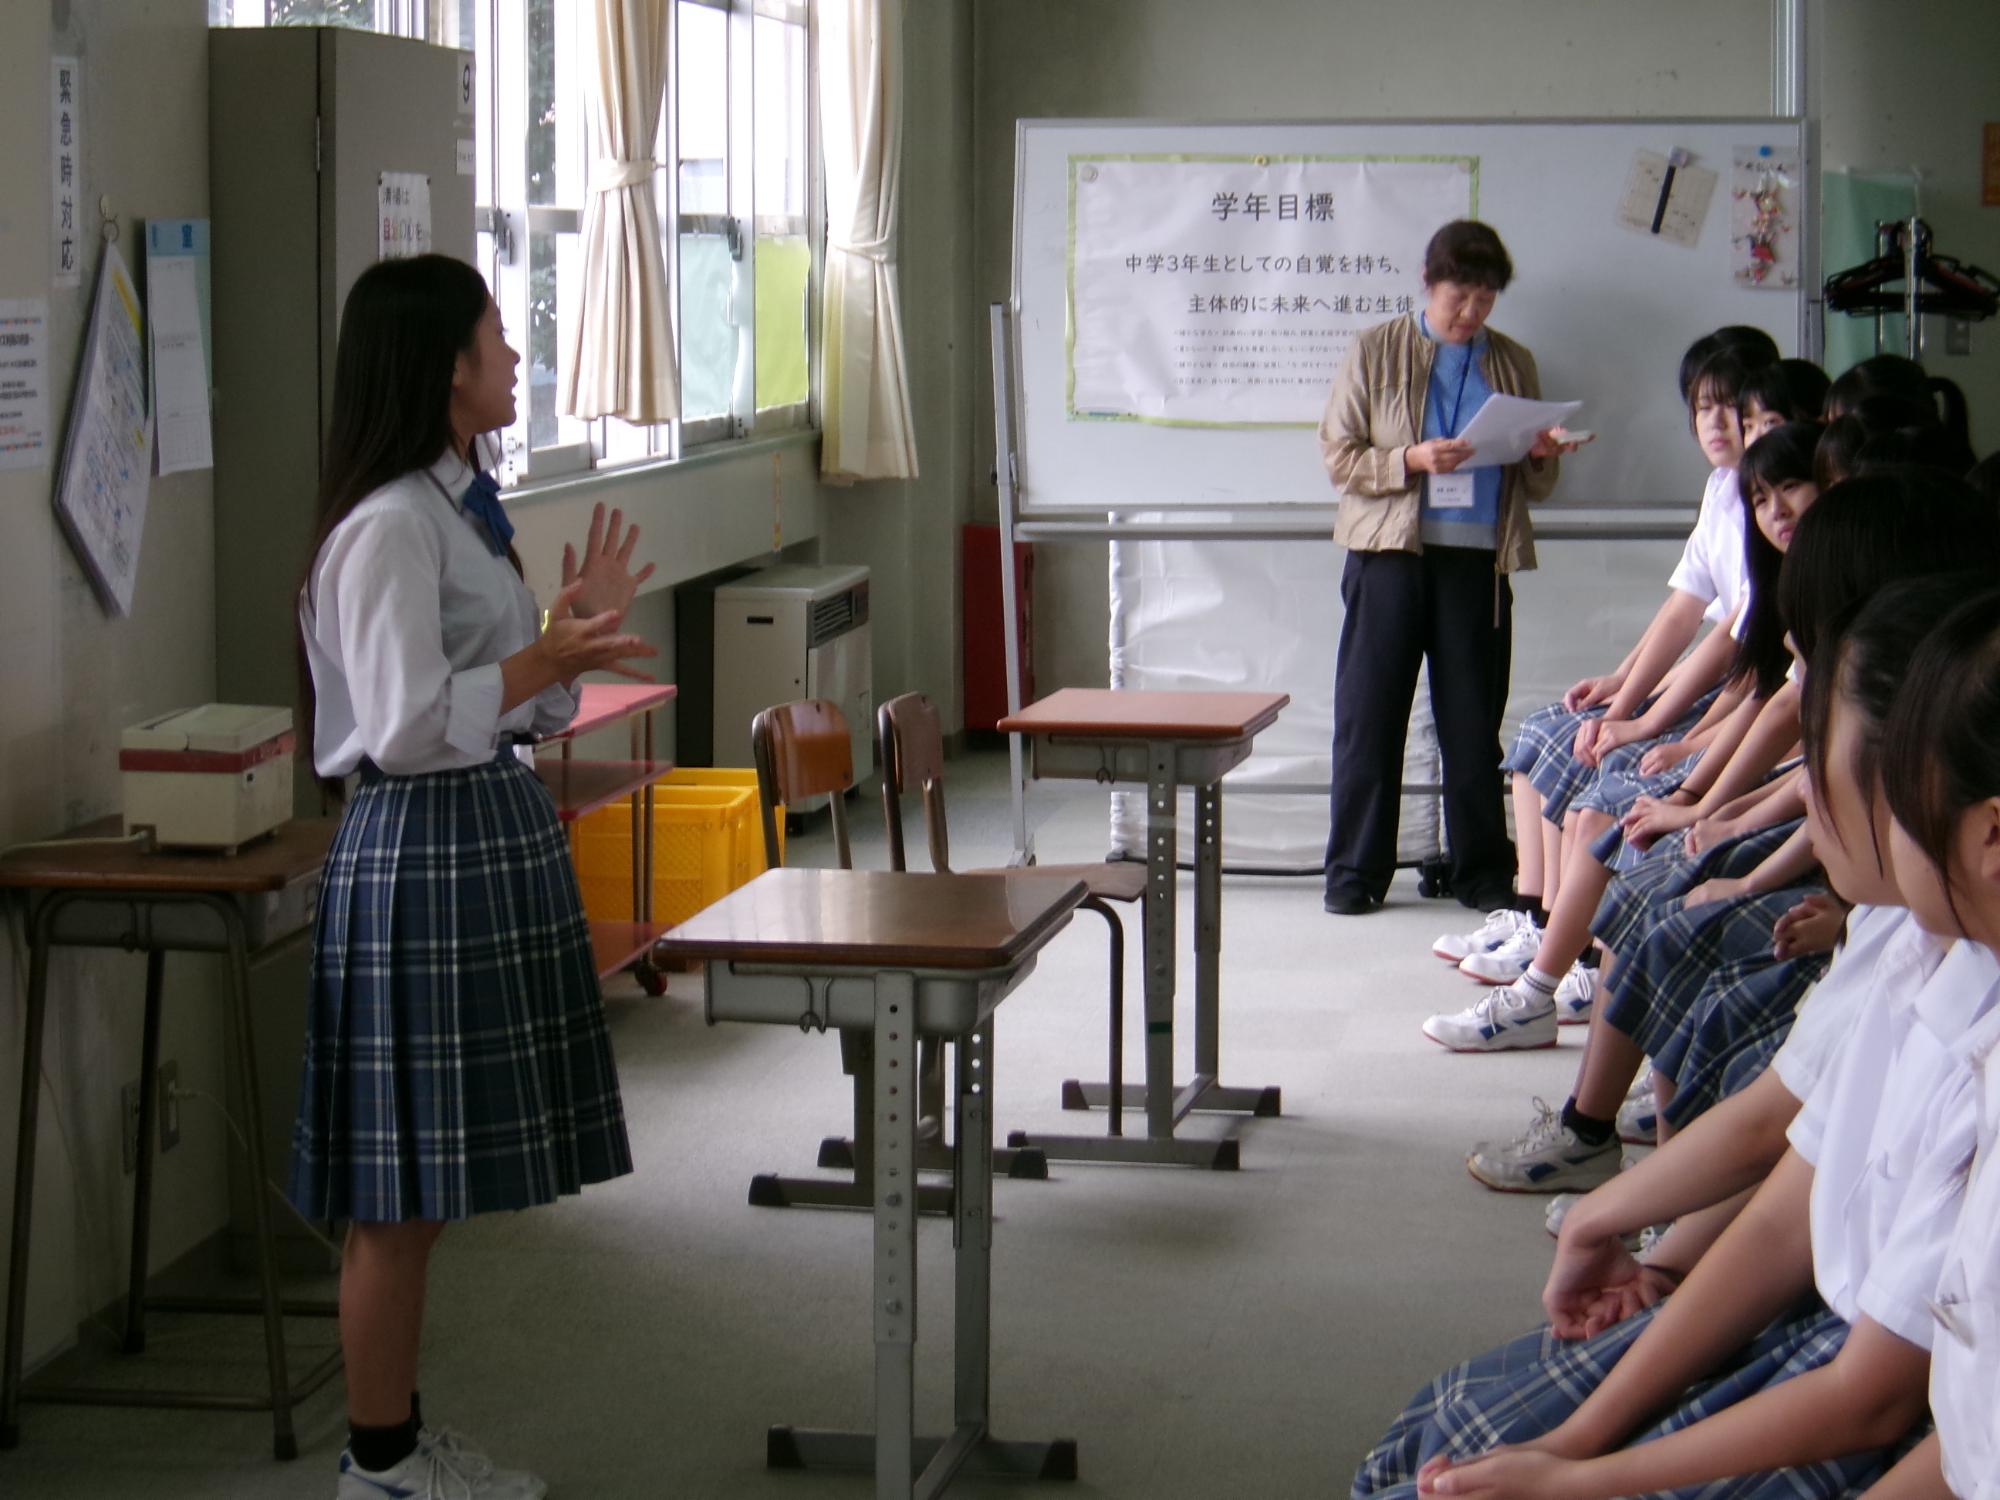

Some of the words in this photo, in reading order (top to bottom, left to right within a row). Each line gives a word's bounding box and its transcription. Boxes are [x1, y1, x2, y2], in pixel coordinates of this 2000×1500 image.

[462, 64, 471, 104] 9
[59, 69, 74, 271] 緊急時対応
[1211, 191, 1336, 222] 学年目標
[1125, 253, 1401, 275] 中学3年生としての自覚を持ち、
[1188, 293, 1415, 314] 主体的に未来へ進む生徒
